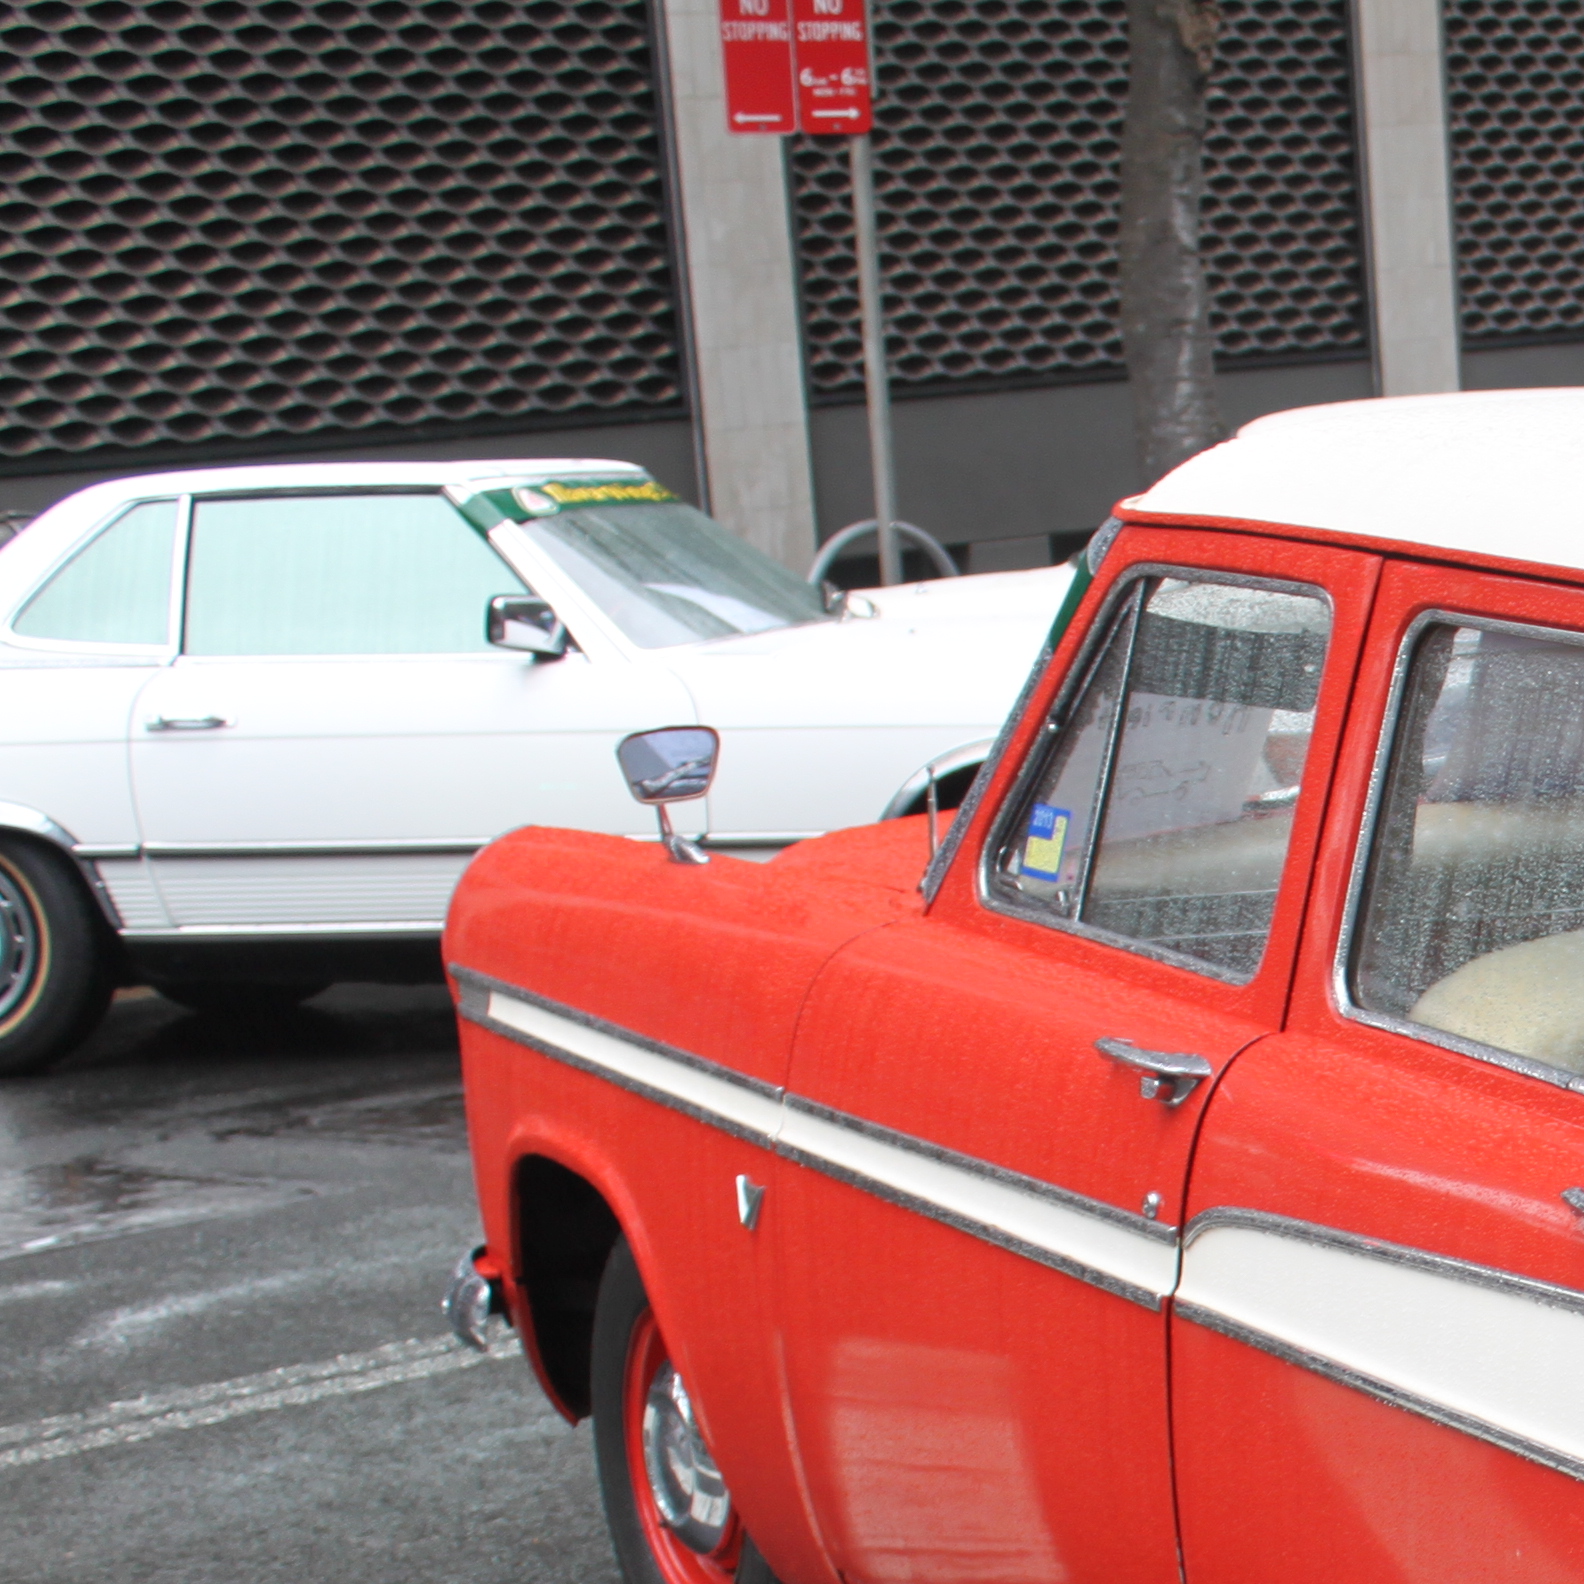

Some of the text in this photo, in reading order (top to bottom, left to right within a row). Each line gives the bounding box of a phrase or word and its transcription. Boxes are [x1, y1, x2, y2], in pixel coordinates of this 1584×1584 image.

[739, 0, 769, 16] NO
[813, 0, 843, 15] NO
[722, 21, 789, 42] STOPPING
[798, 21, 862, 42] STOPPING
